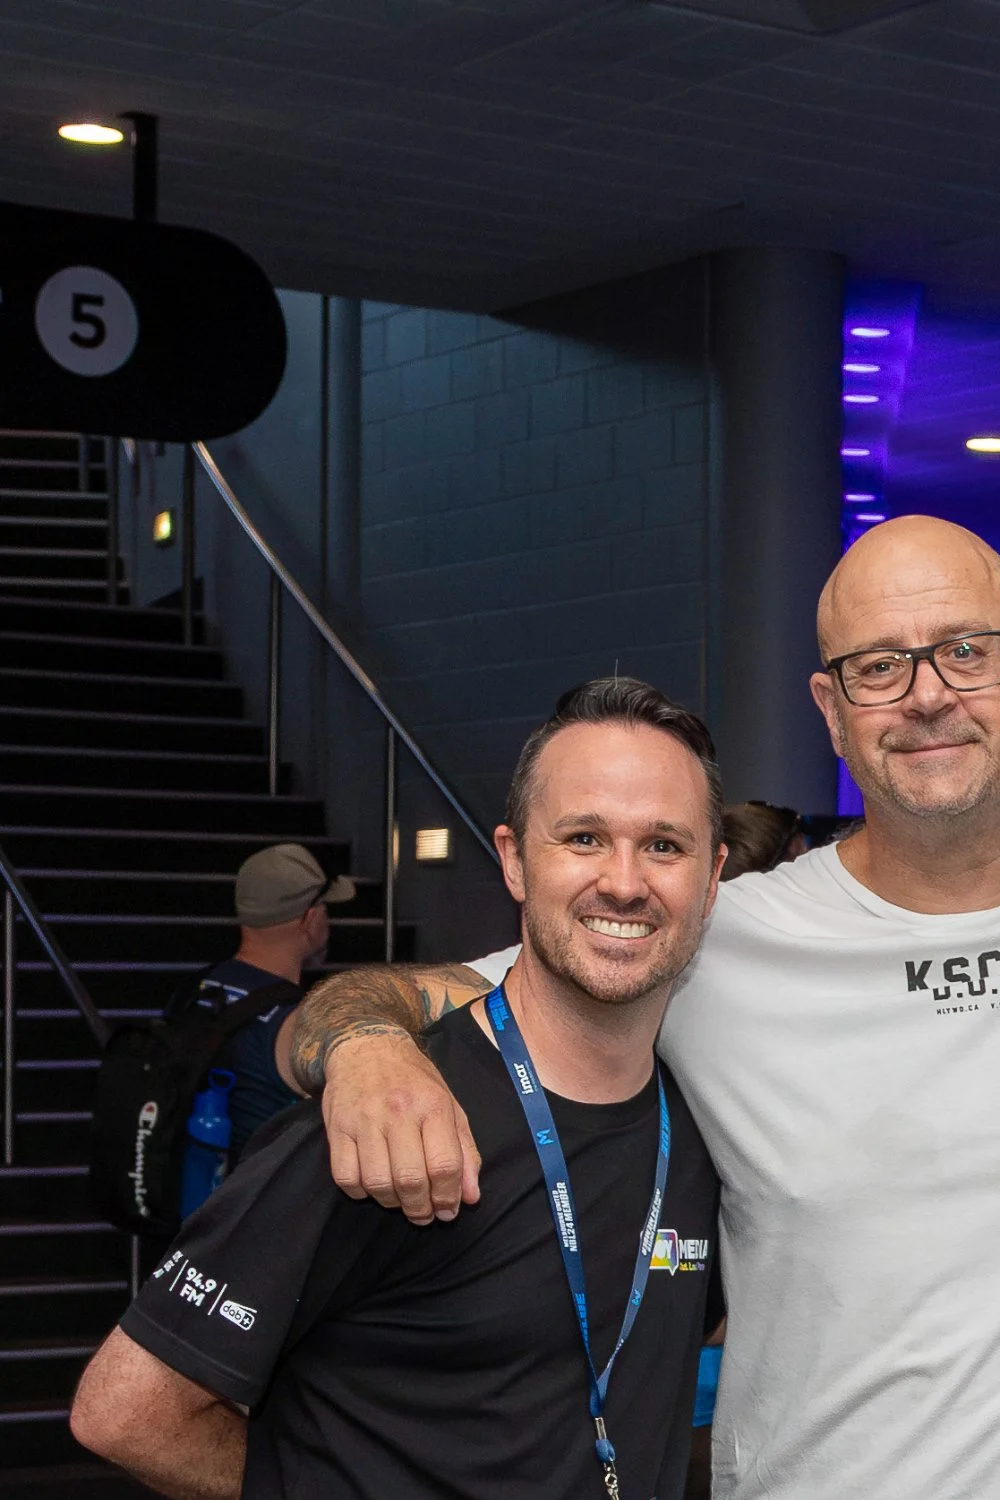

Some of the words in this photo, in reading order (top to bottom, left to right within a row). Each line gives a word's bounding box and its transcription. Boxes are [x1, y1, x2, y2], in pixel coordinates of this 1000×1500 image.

[69, 292, 107, 348] 5
[556, 1180, 573, 1222] MEMBER
[564, 1221, 579, 1252] NBL24
[180, 1283, 205, 1307] FM
[186, 1268, 217, 1293] 94.9
